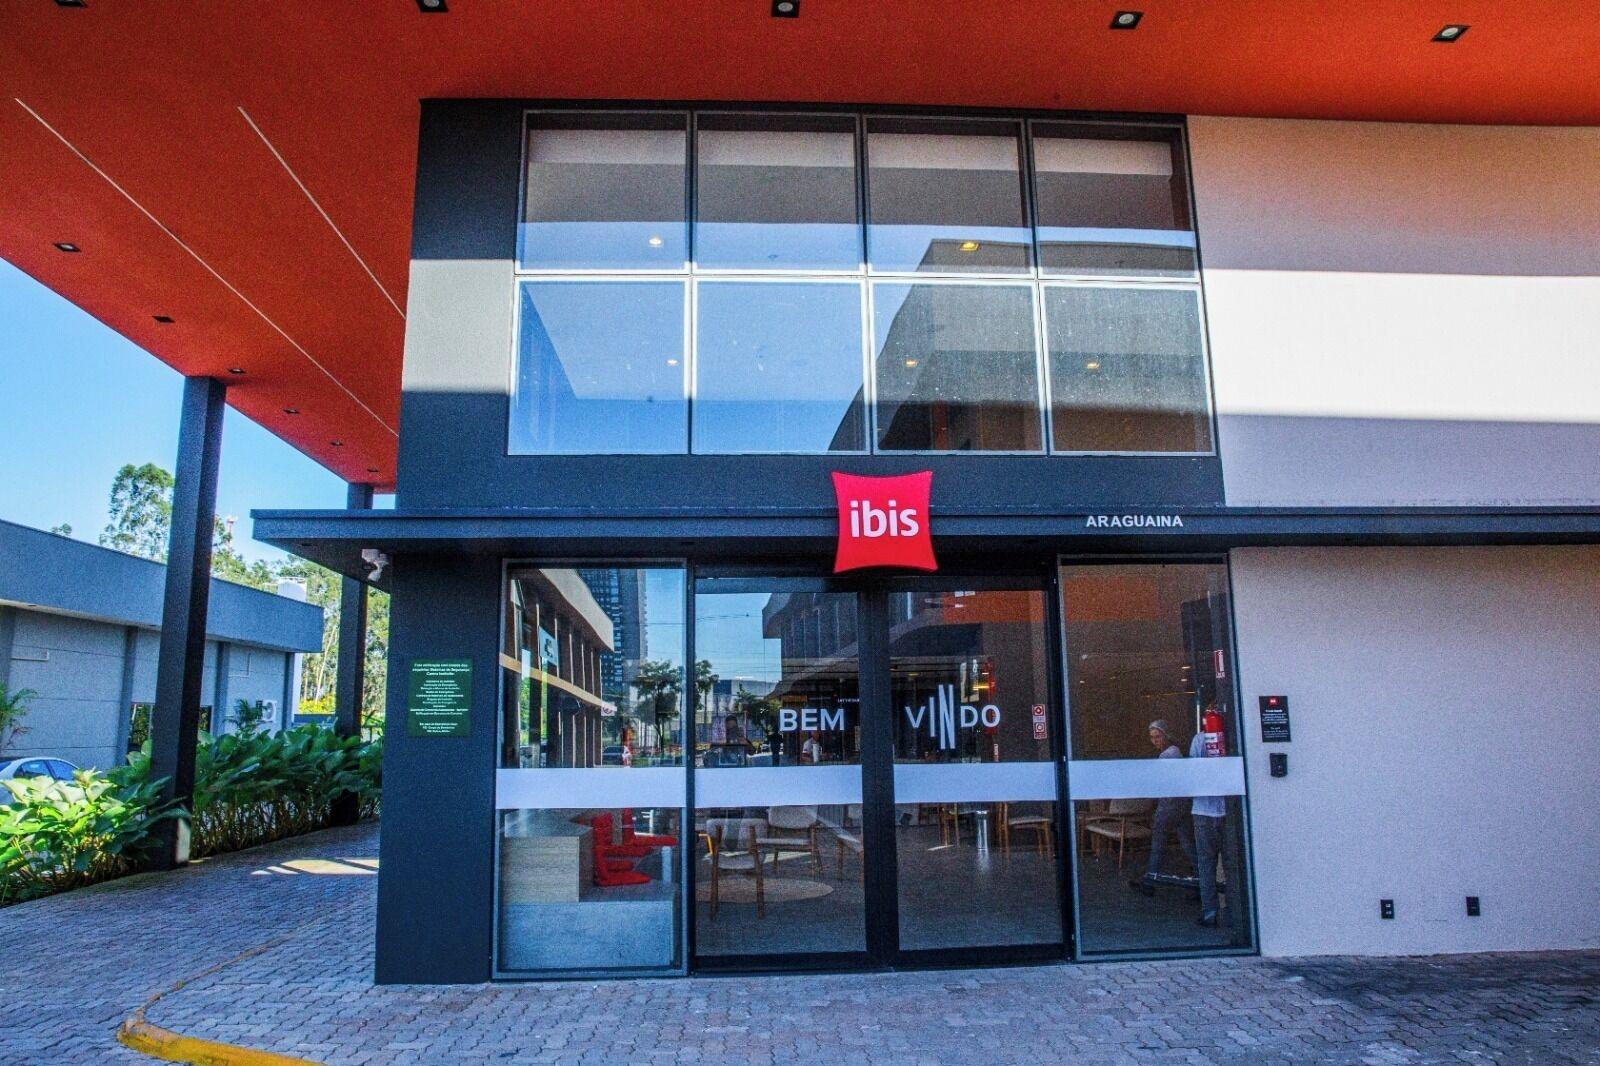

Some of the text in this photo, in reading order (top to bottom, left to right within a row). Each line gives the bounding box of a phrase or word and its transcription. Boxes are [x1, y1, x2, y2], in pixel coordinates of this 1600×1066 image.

[850, 500, 919, 537] ibis
[1086, 515, 1184, 528] ARAGUAINA
[779, 684, 1001, 750] BEM VINDO
